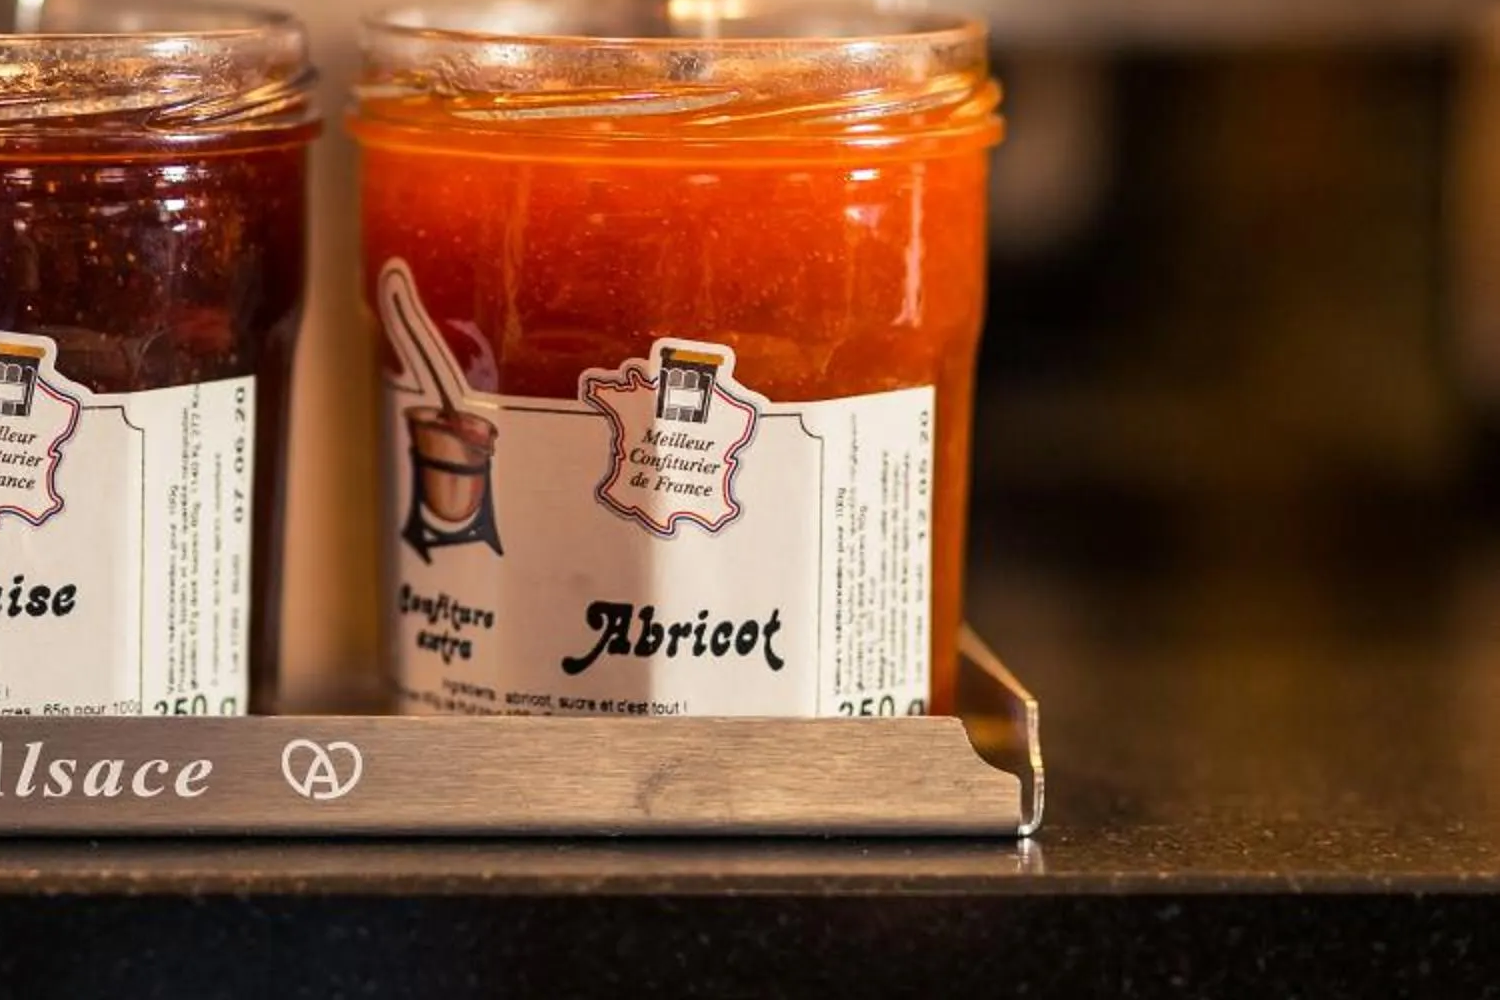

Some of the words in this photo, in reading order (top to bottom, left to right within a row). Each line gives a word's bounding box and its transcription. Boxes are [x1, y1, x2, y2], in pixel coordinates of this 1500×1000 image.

[642, 429, 715, 451] Meilleur
[629, 447, 720, 475] Confiturier
[629, 471, 649, 488] de
[654, 475, 713, 497] France
[561, 600, 785, 676] Abricot
[559, 696, 596, 711] sucre
[599, 698, 614, 712] et
[617, 699, 648, 714] c'est
[652, 700, 679, 714] tout
